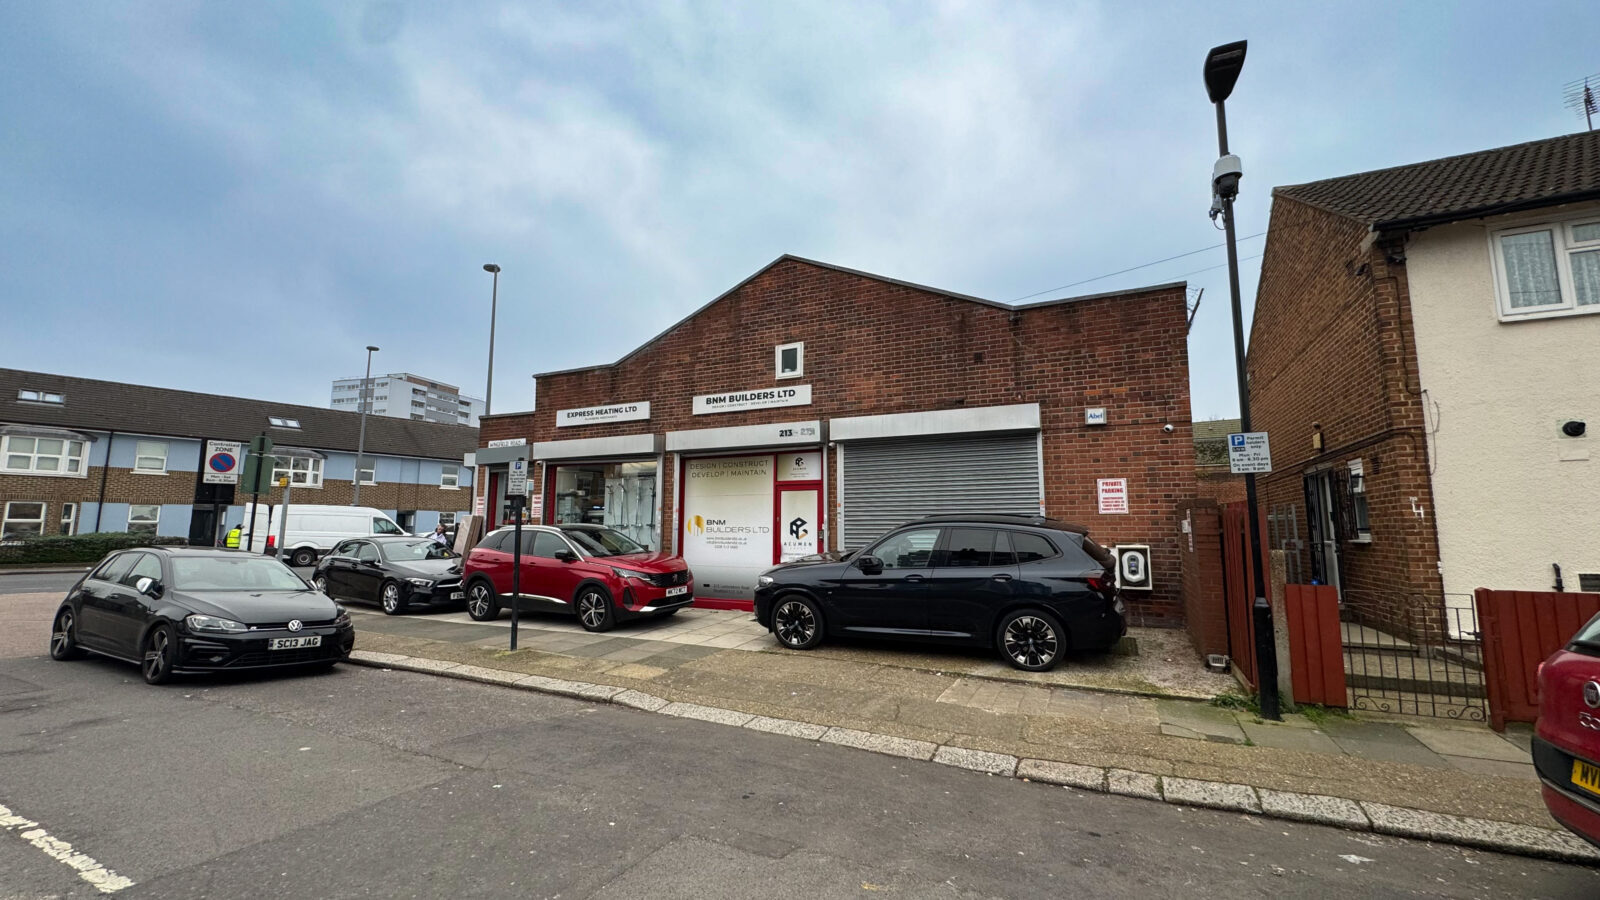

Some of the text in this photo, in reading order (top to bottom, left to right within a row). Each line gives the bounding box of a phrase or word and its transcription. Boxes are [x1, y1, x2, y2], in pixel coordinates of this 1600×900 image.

[706, 389, 796, 405] BNM BUILDERS LTD
[567, 405, 638, 419] EXPRESS HEATING LTD
[779, 429, 793, 437] 213
[1234, 436, 1243, 445] P
[722, 460, 769, 469] CONSTRUCT
[691, 469, 767, 478] DEVELOP MAINTAIN
[706, 526, 770, 534] BUILDERS LTD
[277, 637, 319, 649] SC13 JAG
[1580, 762, 1600, 790] MV
